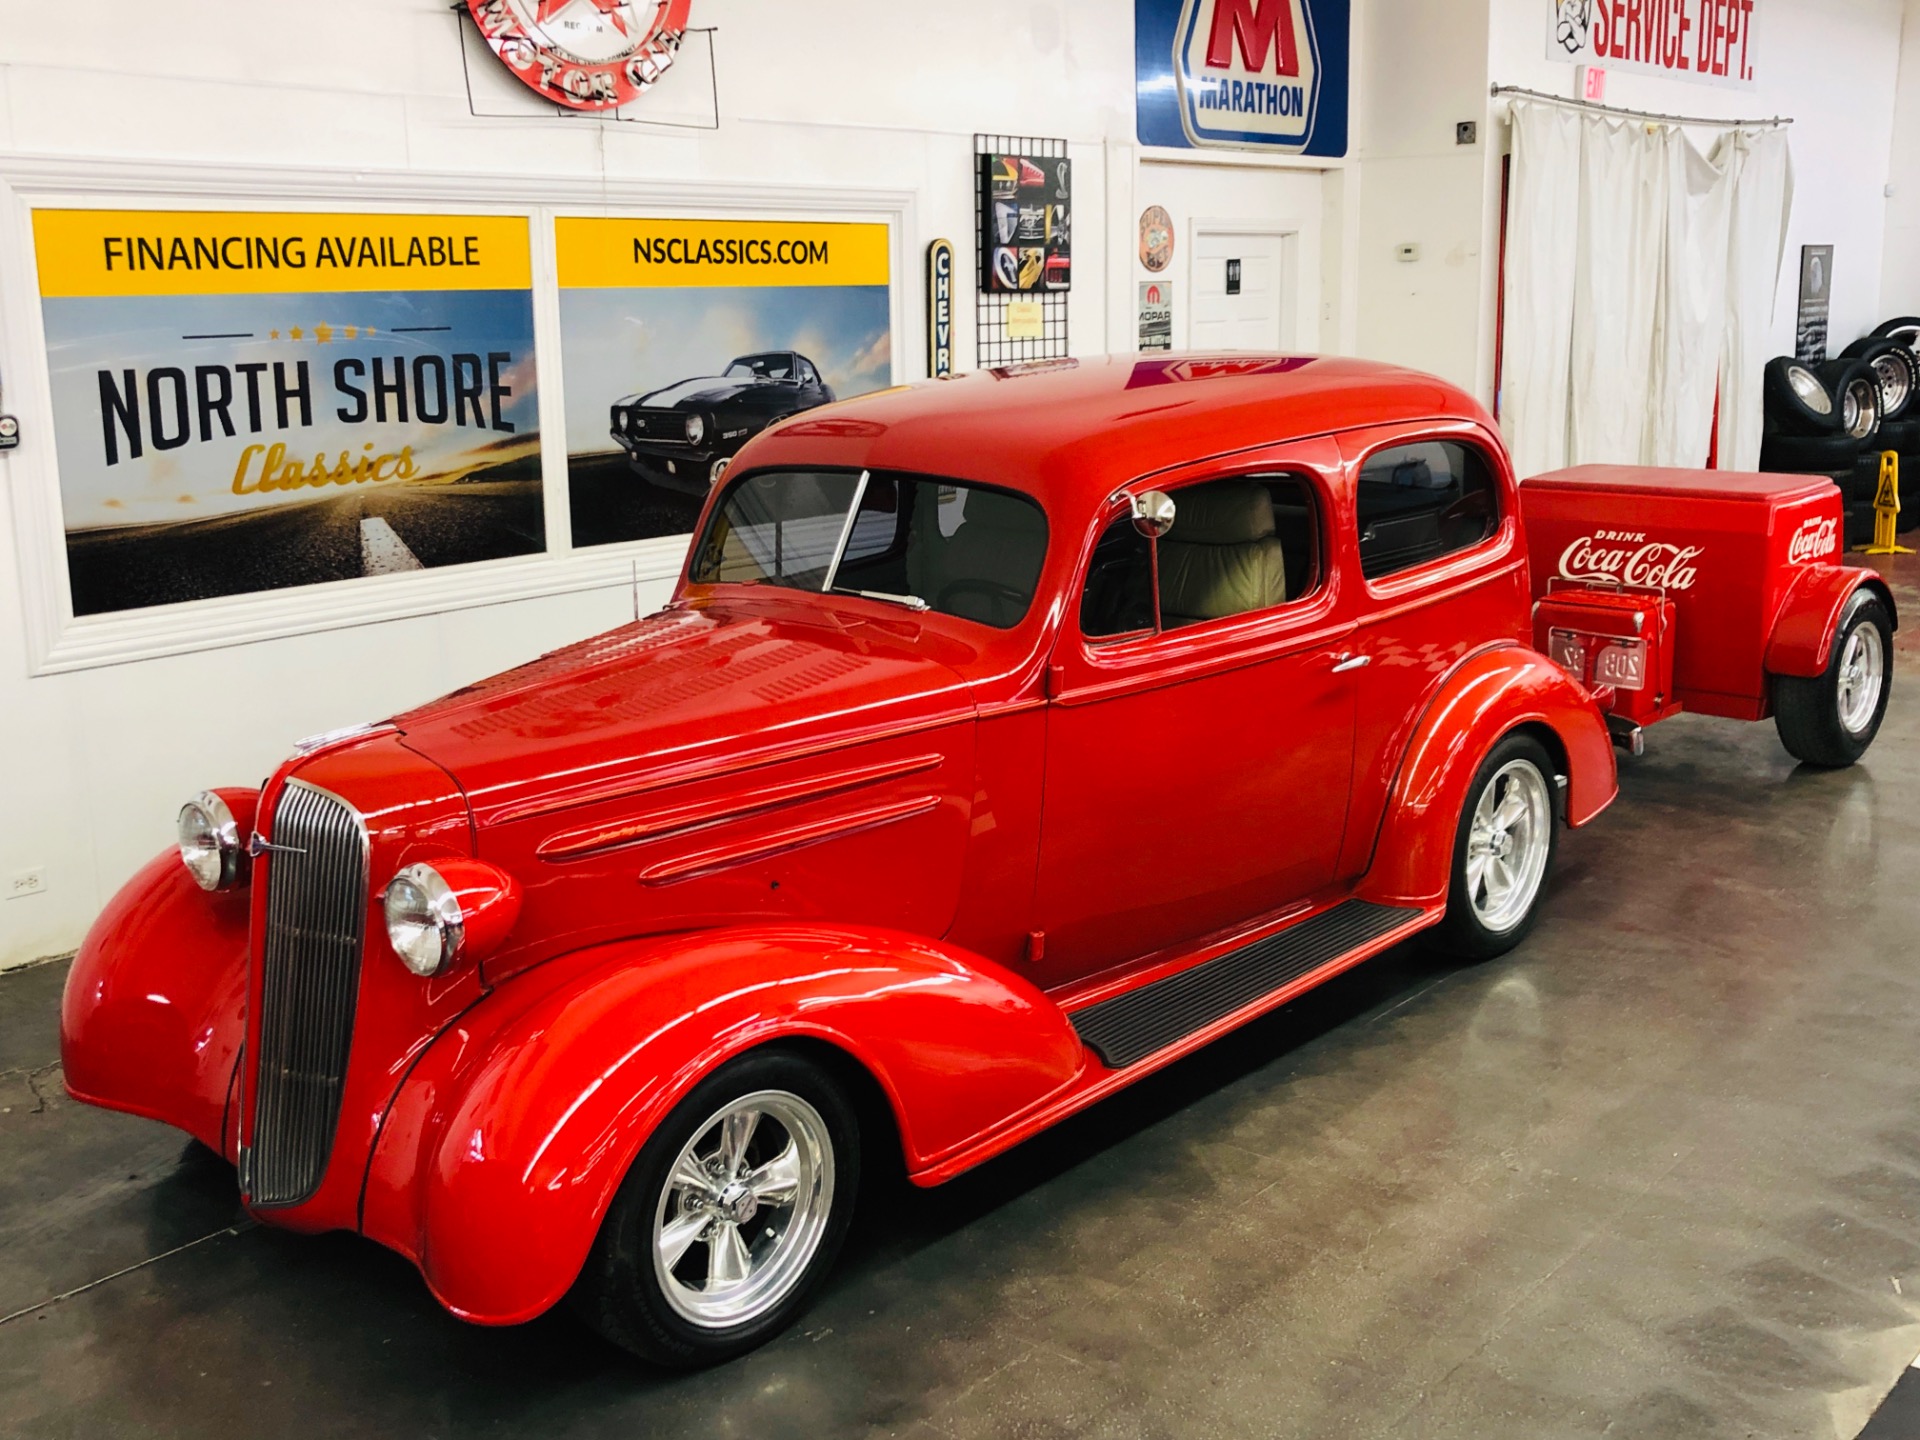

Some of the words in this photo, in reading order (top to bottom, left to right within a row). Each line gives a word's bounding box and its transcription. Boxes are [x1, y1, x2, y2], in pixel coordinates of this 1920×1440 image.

[1593, 0, 1691, 70] SERVICE
[1697, 0, 1753, 81] DEPT.
[1200, 76, 1304, 117] MARATHON
[103, 236, 306, 271] FINANCING
[315, 236, 480, 268] AVAILABLE
[632, 237, 829, 265] NSCLASSICS.COM
[937, 252, 950, 377] CHEVR
[97, 359, 313, 467] NORTH
[333, 351, 516, 434] SHORE
[231, 441, 420, 496] Classics
[1558, 536, 1705, 590] Coca-Cola
[1594, 529, 1646, 543] DRINK
